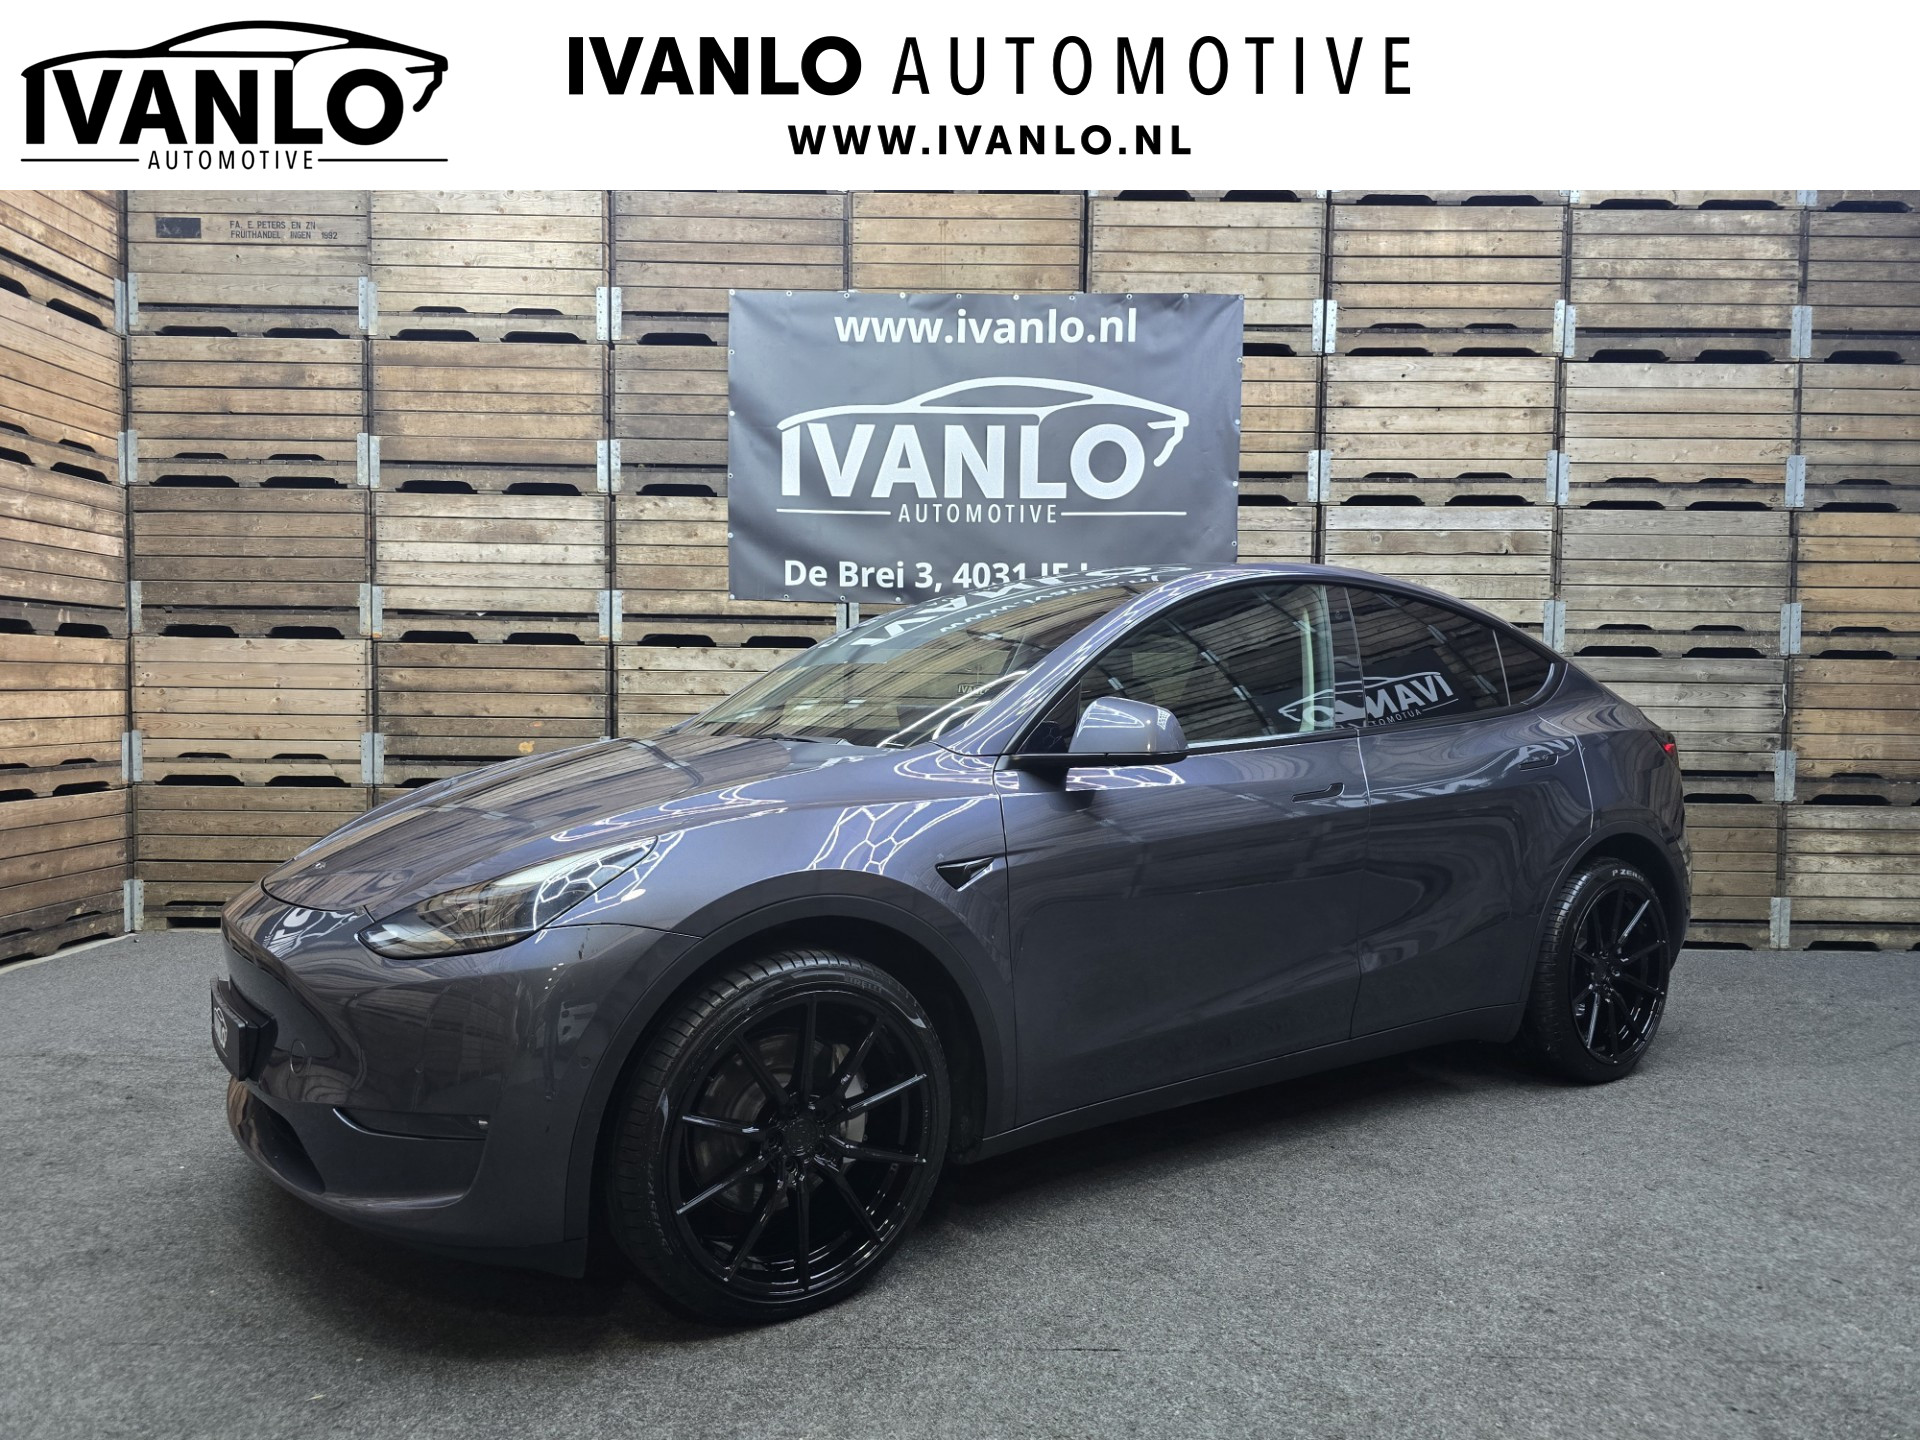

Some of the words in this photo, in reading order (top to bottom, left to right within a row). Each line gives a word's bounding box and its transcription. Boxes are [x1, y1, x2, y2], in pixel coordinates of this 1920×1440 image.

[230, 230, 281, 239] FRUITHANDEL
[290, 231, 311, 240] INGEN
[257, 220, 286, 230] PETERS
[291, 221, 301, 230] EN
[305, 221, 316, 230] ZN
[834, 308, 1137, 345] www.ivanlo.nl
[781, 423, 1146, 500] IVANLO
[898, 504, 1057, 524] AUTOMOTIVE
[784, 560, 828, 587] De
[839, 560, 904, 589] Brei
[915, 562, 942, 593] 3,
[953, 562, 1026, 589] 4031
